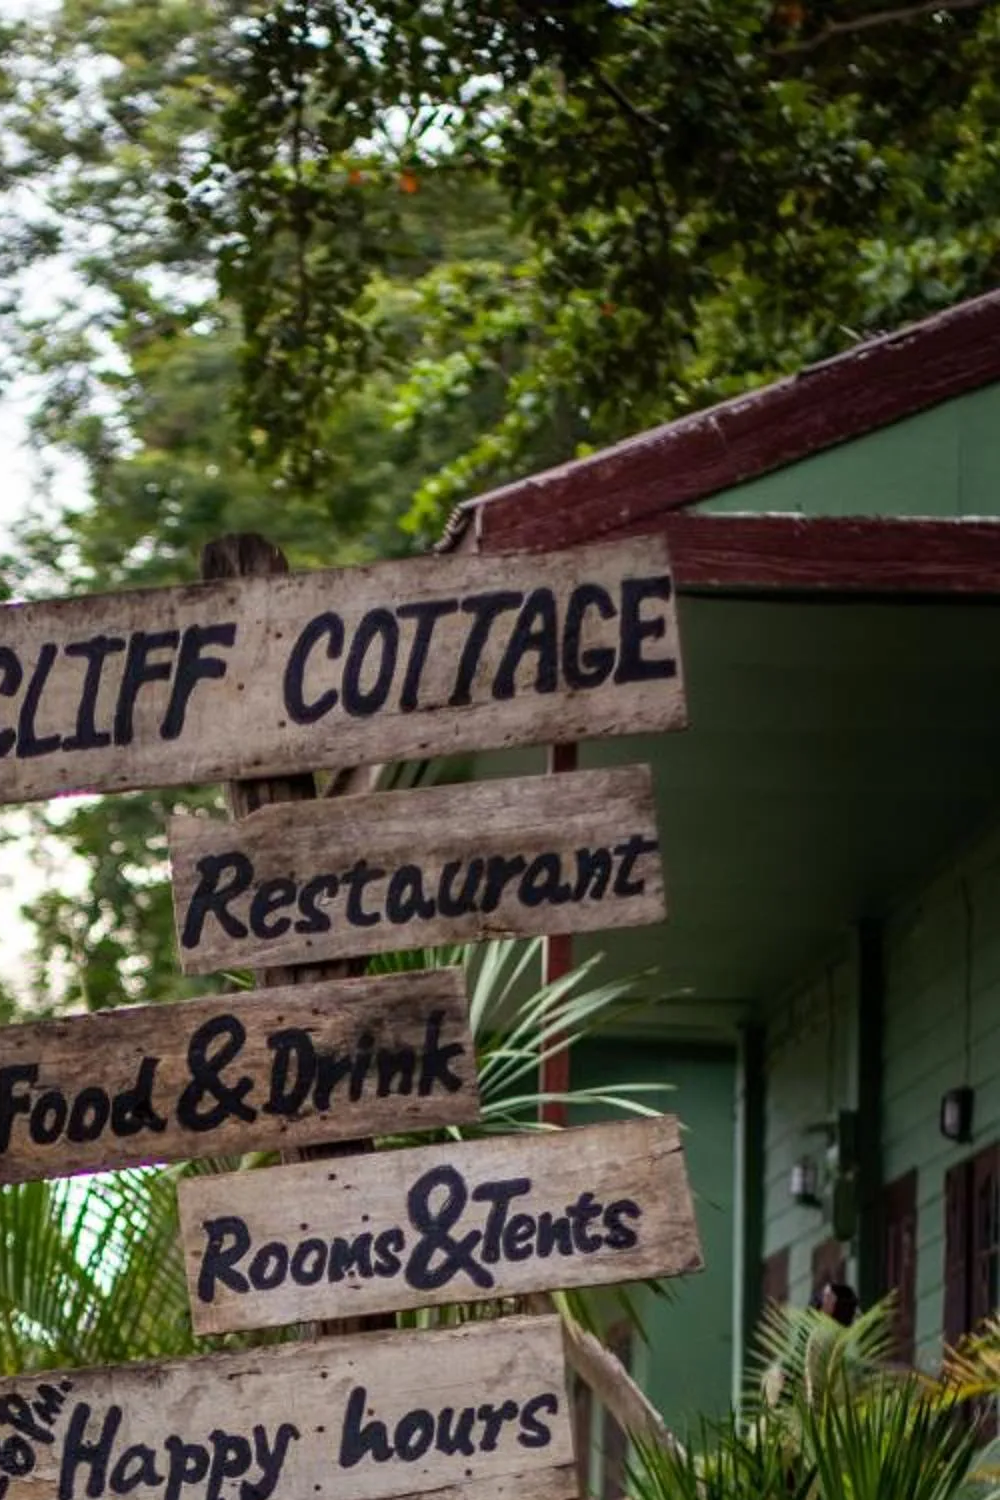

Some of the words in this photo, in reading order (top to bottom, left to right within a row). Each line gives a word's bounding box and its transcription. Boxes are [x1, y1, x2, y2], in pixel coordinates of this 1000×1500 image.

[284, 576, 678, 725] COTTAGE
[181, 837, 660, 949] Restaurant
[341, 1387, 560, 1467] hours
